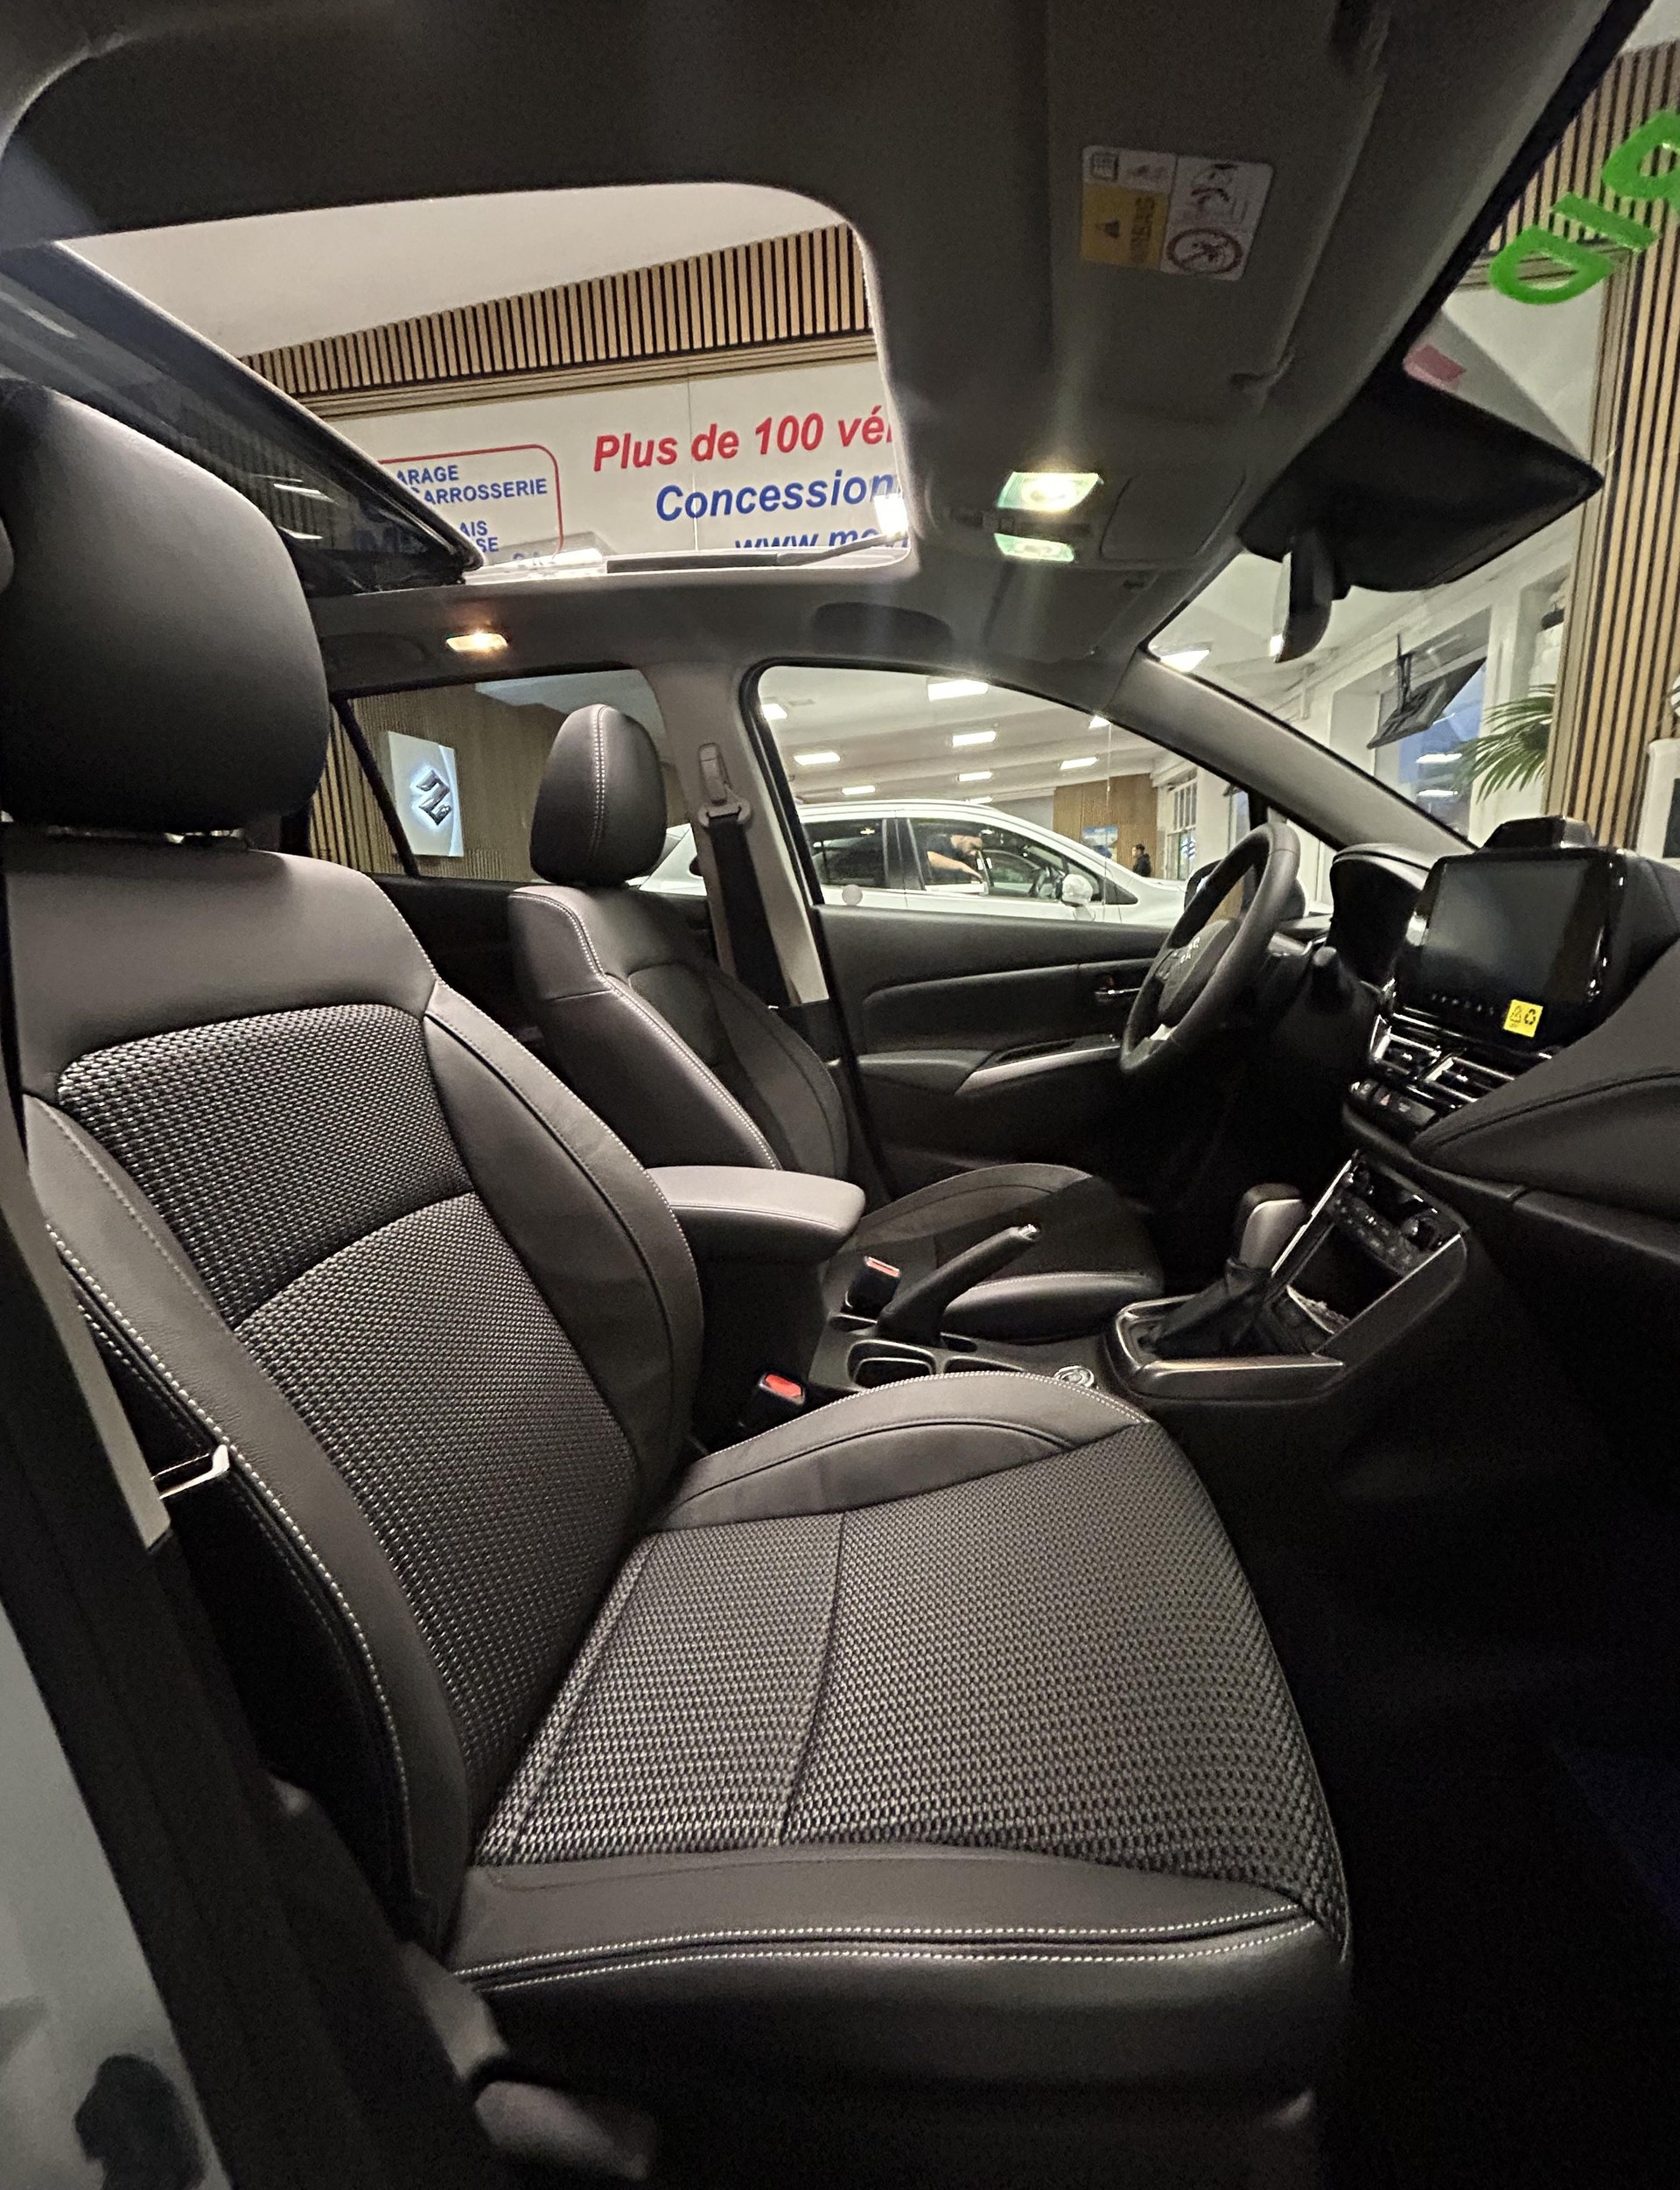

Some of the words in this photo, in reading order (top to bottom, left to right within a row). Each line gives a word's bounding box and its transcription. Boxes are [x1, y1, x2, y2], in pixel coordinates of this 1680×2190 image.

[594, 433, 677, 472] Plus
[691, 423, 739, 462] de
[755, 413, 823, 455] 100
[838, 405, 892, 447] vé
[410, 479, 548, 505] ARROSSERIE
